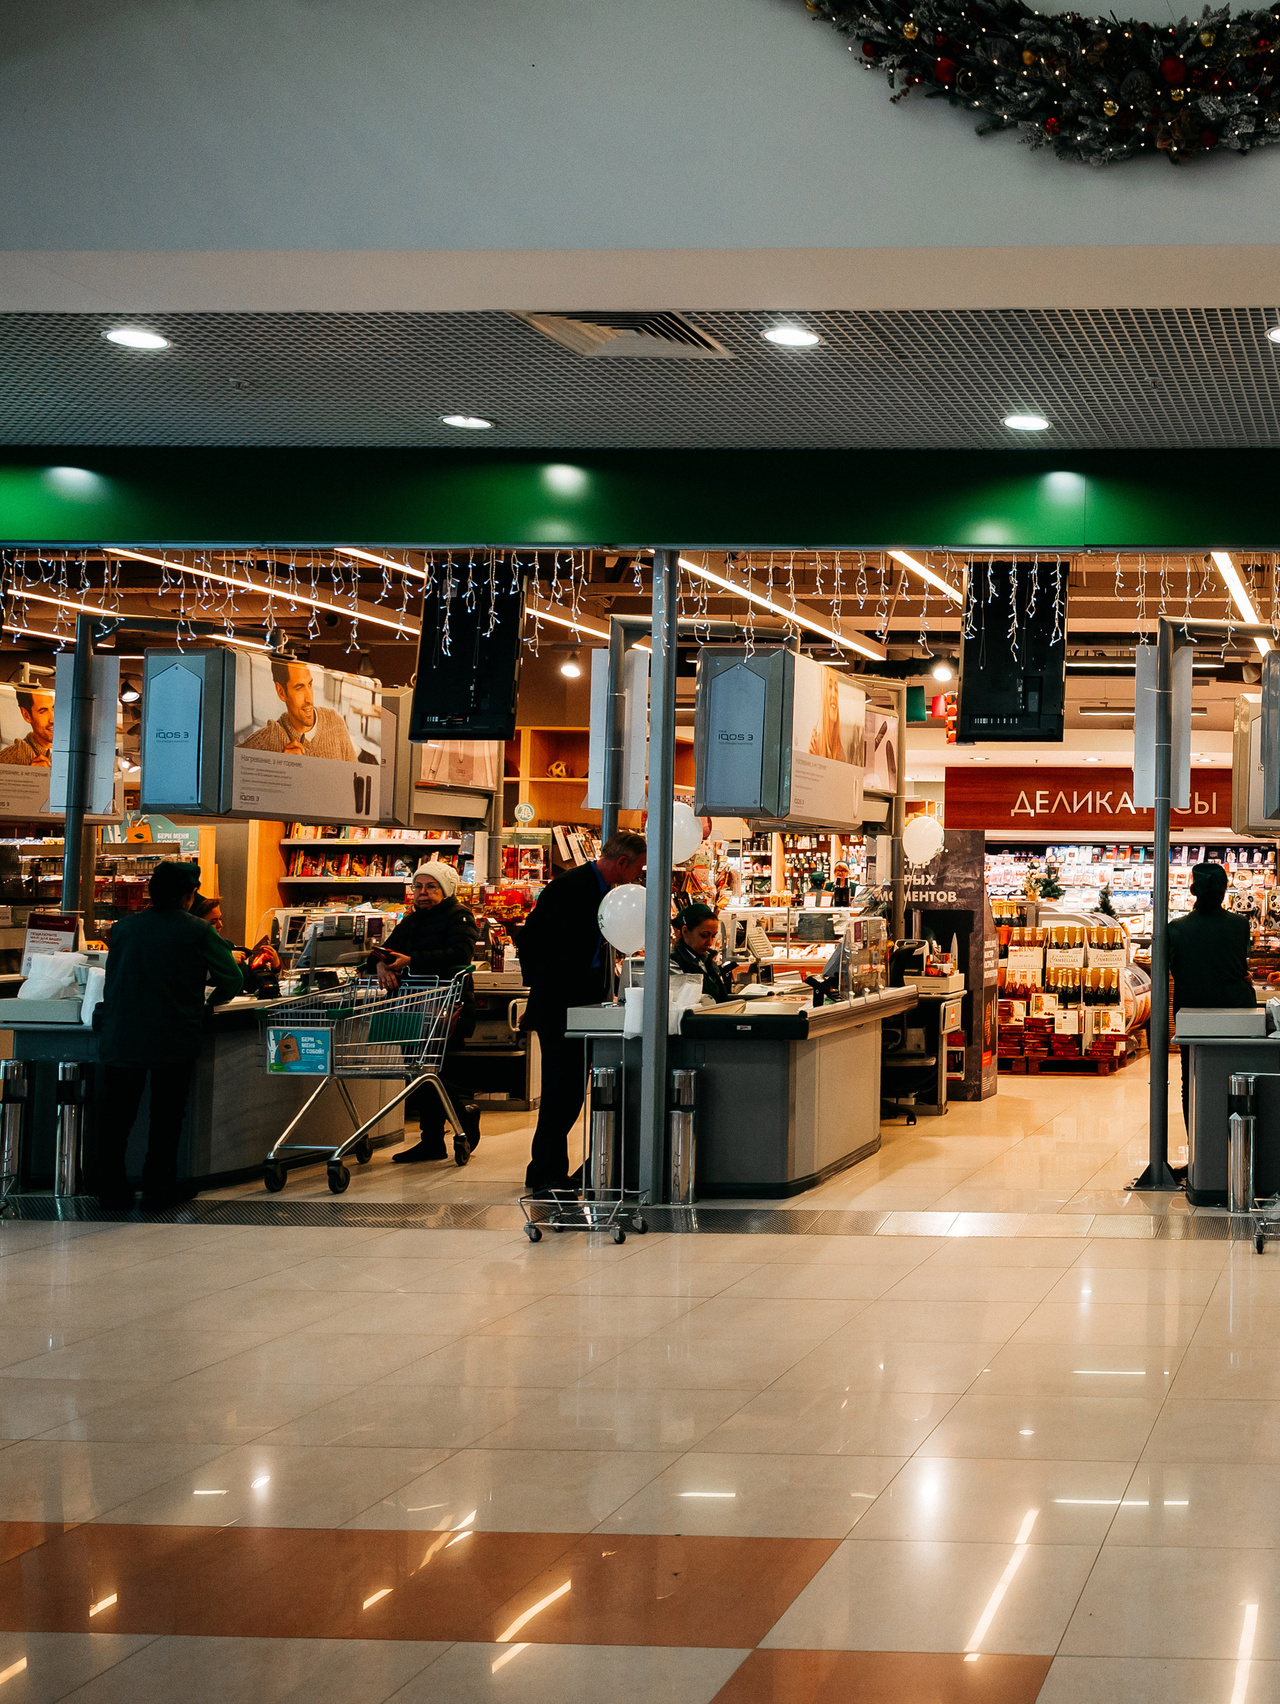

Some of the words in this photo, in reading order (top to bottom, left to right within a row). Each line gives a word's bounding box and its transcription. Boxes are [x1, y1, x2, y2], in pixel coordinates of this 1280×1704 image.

[155, 731, 181, 739] IQOS
[183, 731, 189, 739] 3
[717, 733, 745, 741] IQOS
[747, 733, 754, 741] 3
